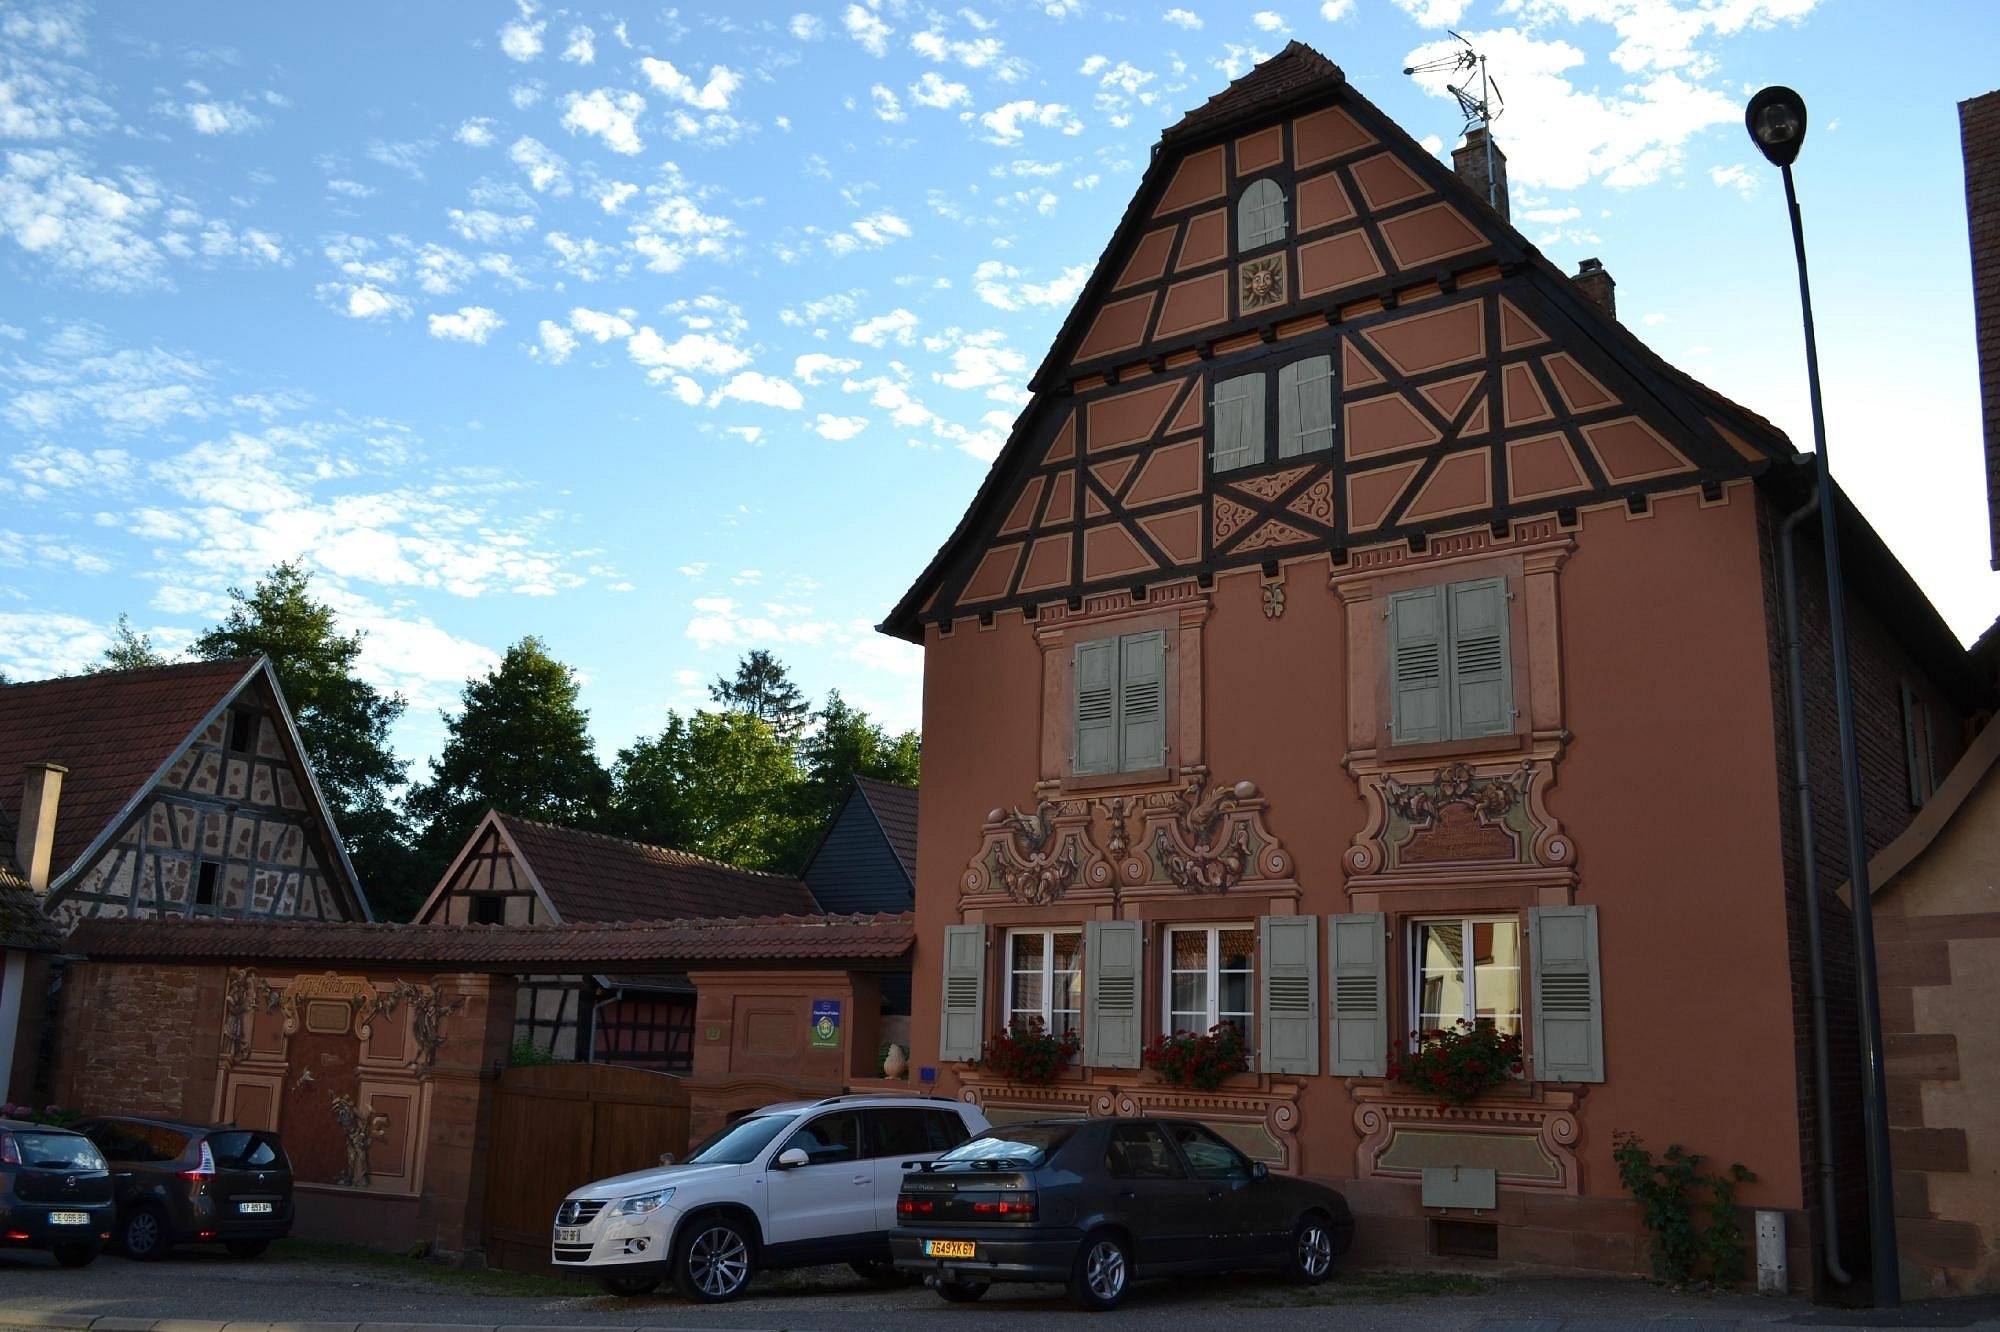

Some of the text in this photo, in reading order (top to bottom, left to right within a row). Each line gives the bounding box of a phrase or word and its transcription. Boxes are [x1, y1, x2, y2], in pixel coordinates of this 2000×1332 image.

[931, 1242, 974, 1255] 7649 XK 67
